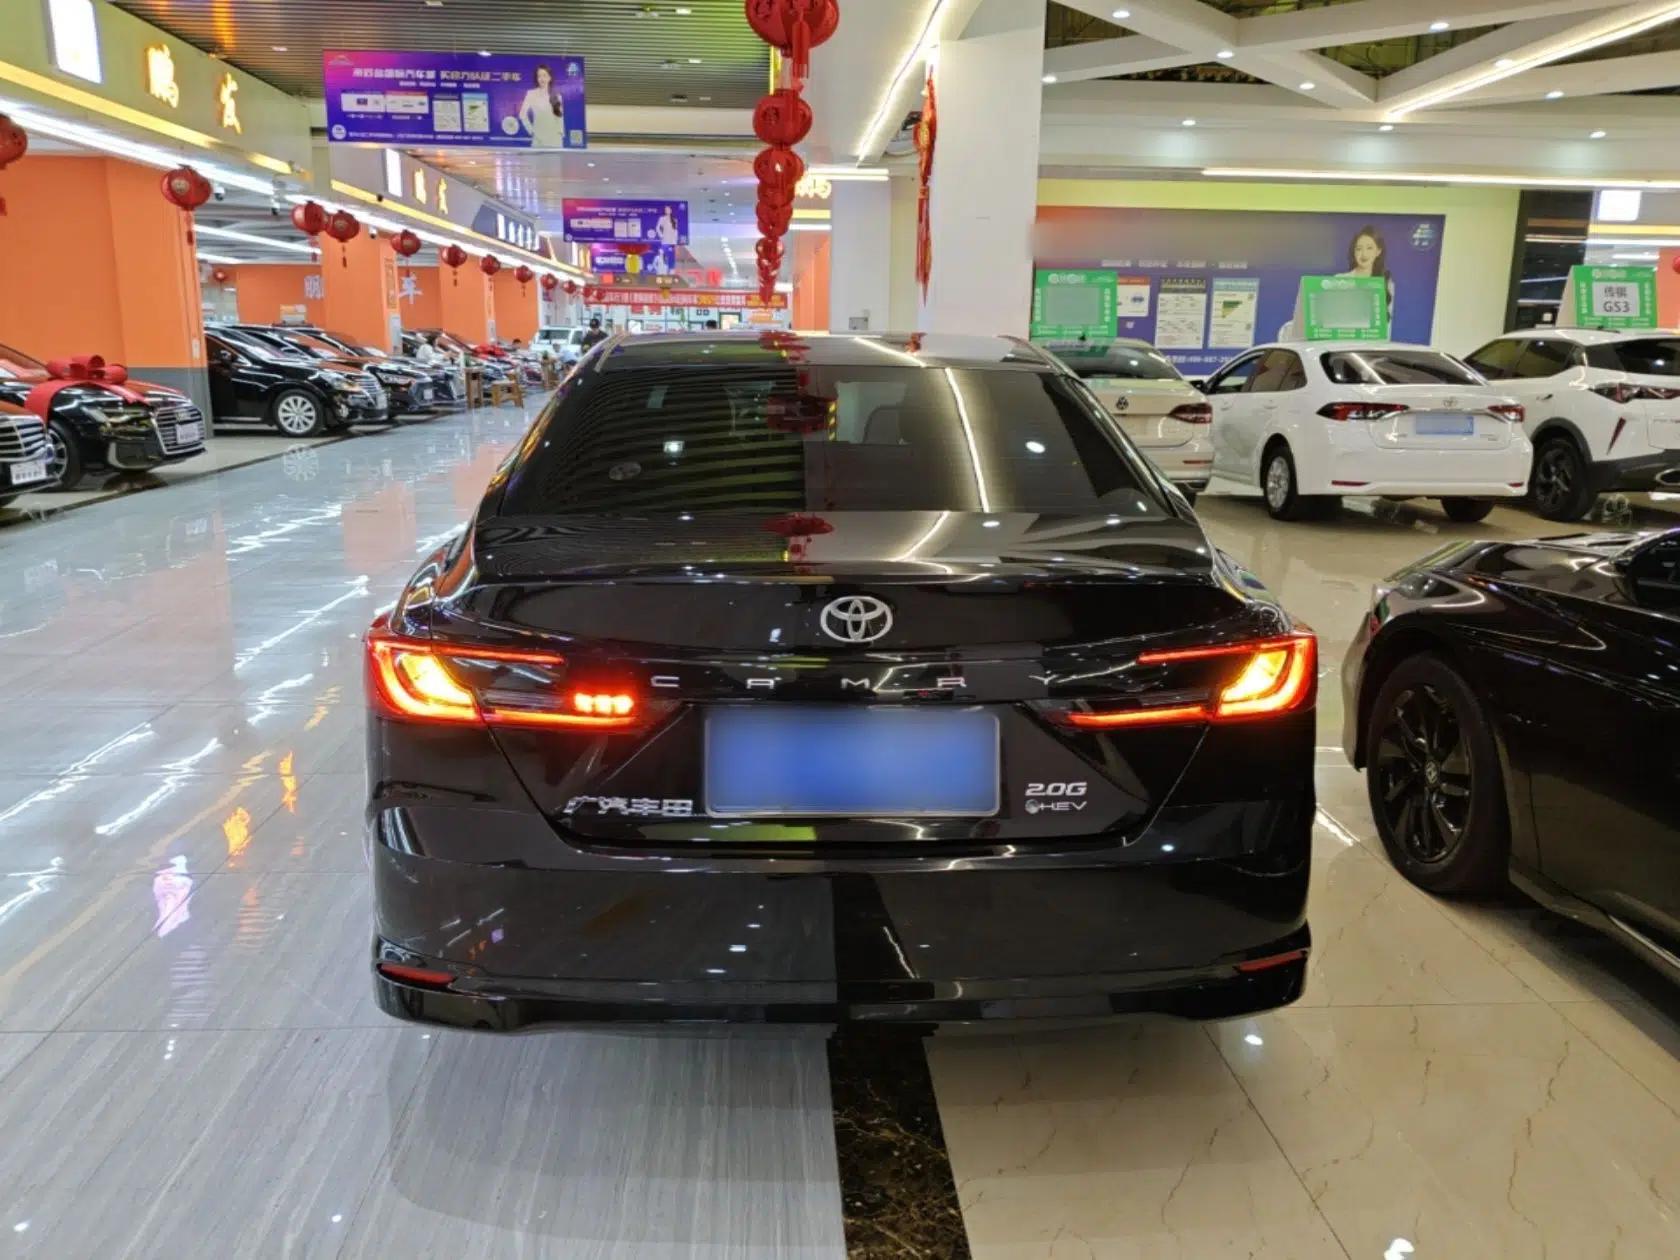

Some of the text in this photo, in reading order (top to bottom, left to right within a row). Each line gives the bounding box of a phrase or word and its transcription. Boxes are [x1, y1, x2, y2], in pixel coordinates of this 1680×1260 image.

[1603, 301, 1630, 313] GS3
[651, 675, 1058, 689] CAMRY
[563, 795, 693, 816] 广汽丰田
